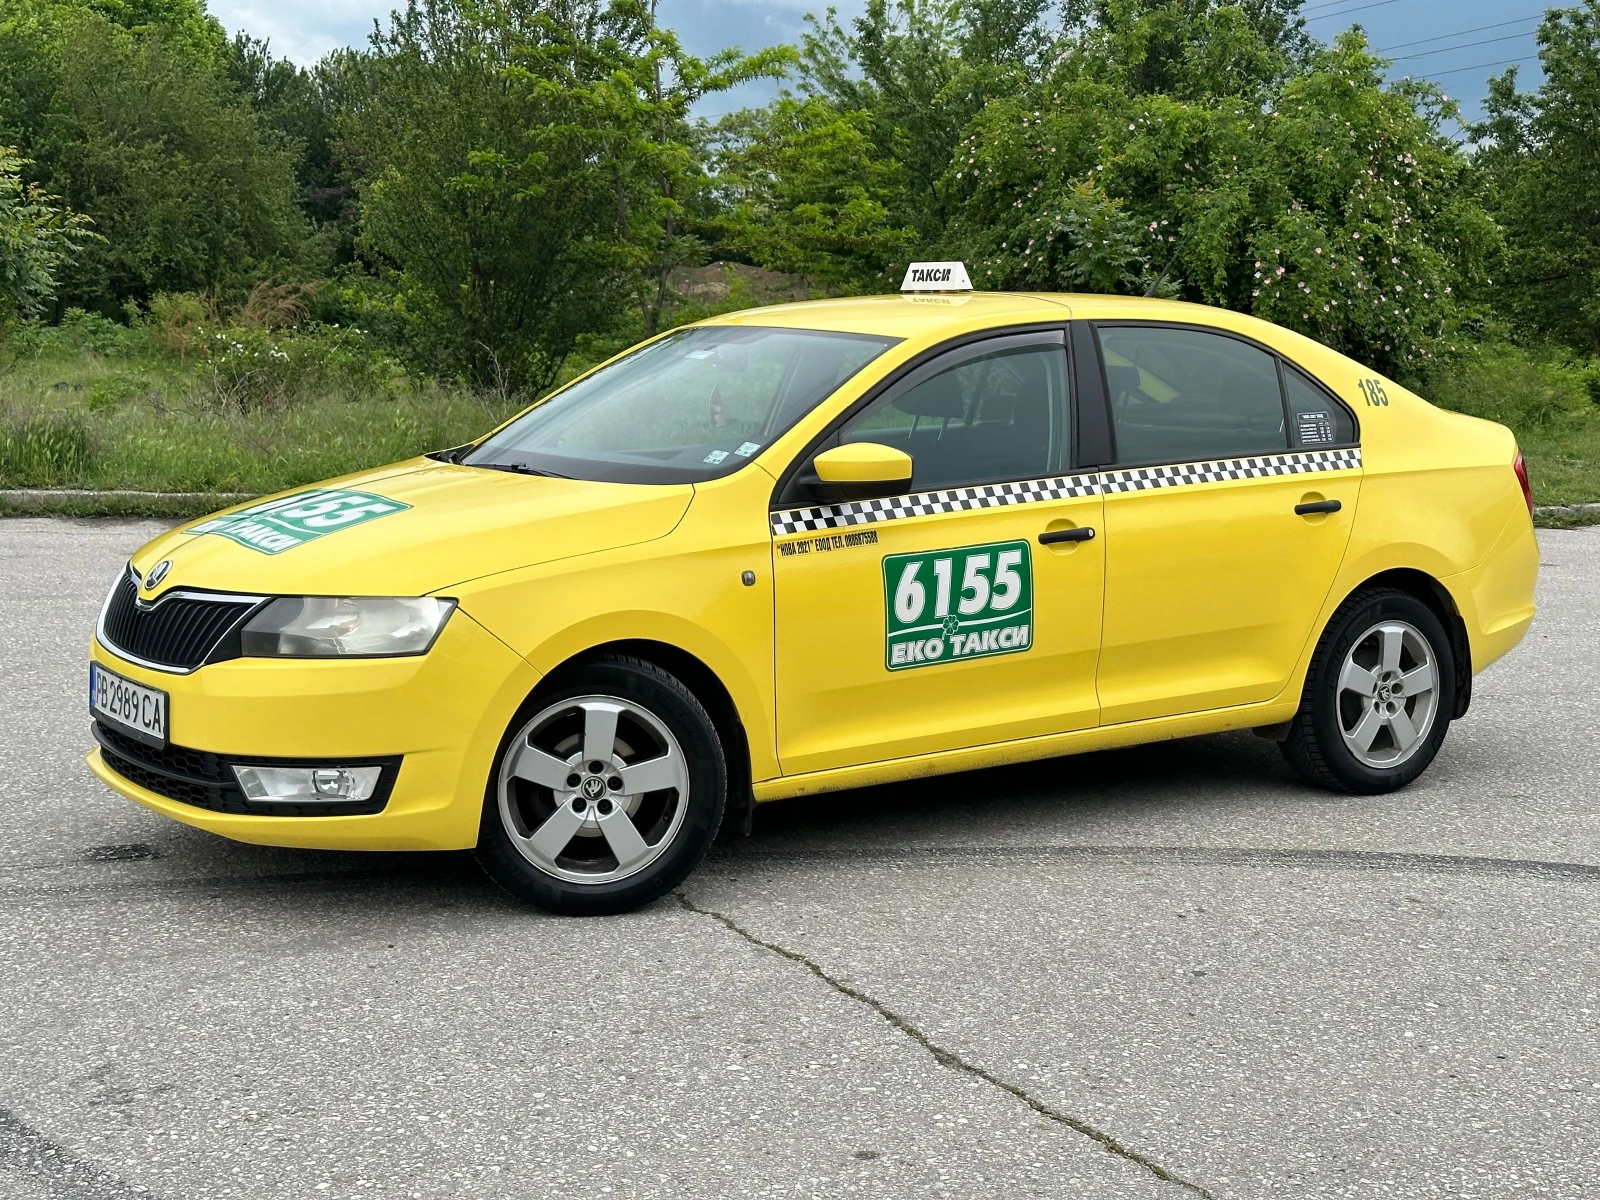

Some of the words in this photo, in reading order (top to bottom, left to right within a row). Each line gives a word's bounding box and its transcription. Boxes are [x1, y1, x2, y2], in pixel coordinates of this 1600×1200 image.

[911, 268, 952, 282] ТАКСИ
[1358, 378, 1389, 407] 185
[894, 549, 1022, 624] 6155
[891, 637, 944, 665] ЕКО
[950, 625, 1029, 656] ТАКСИ
[110, 681, 139, 723] 2989
[143, 694, 162, 733] CA
